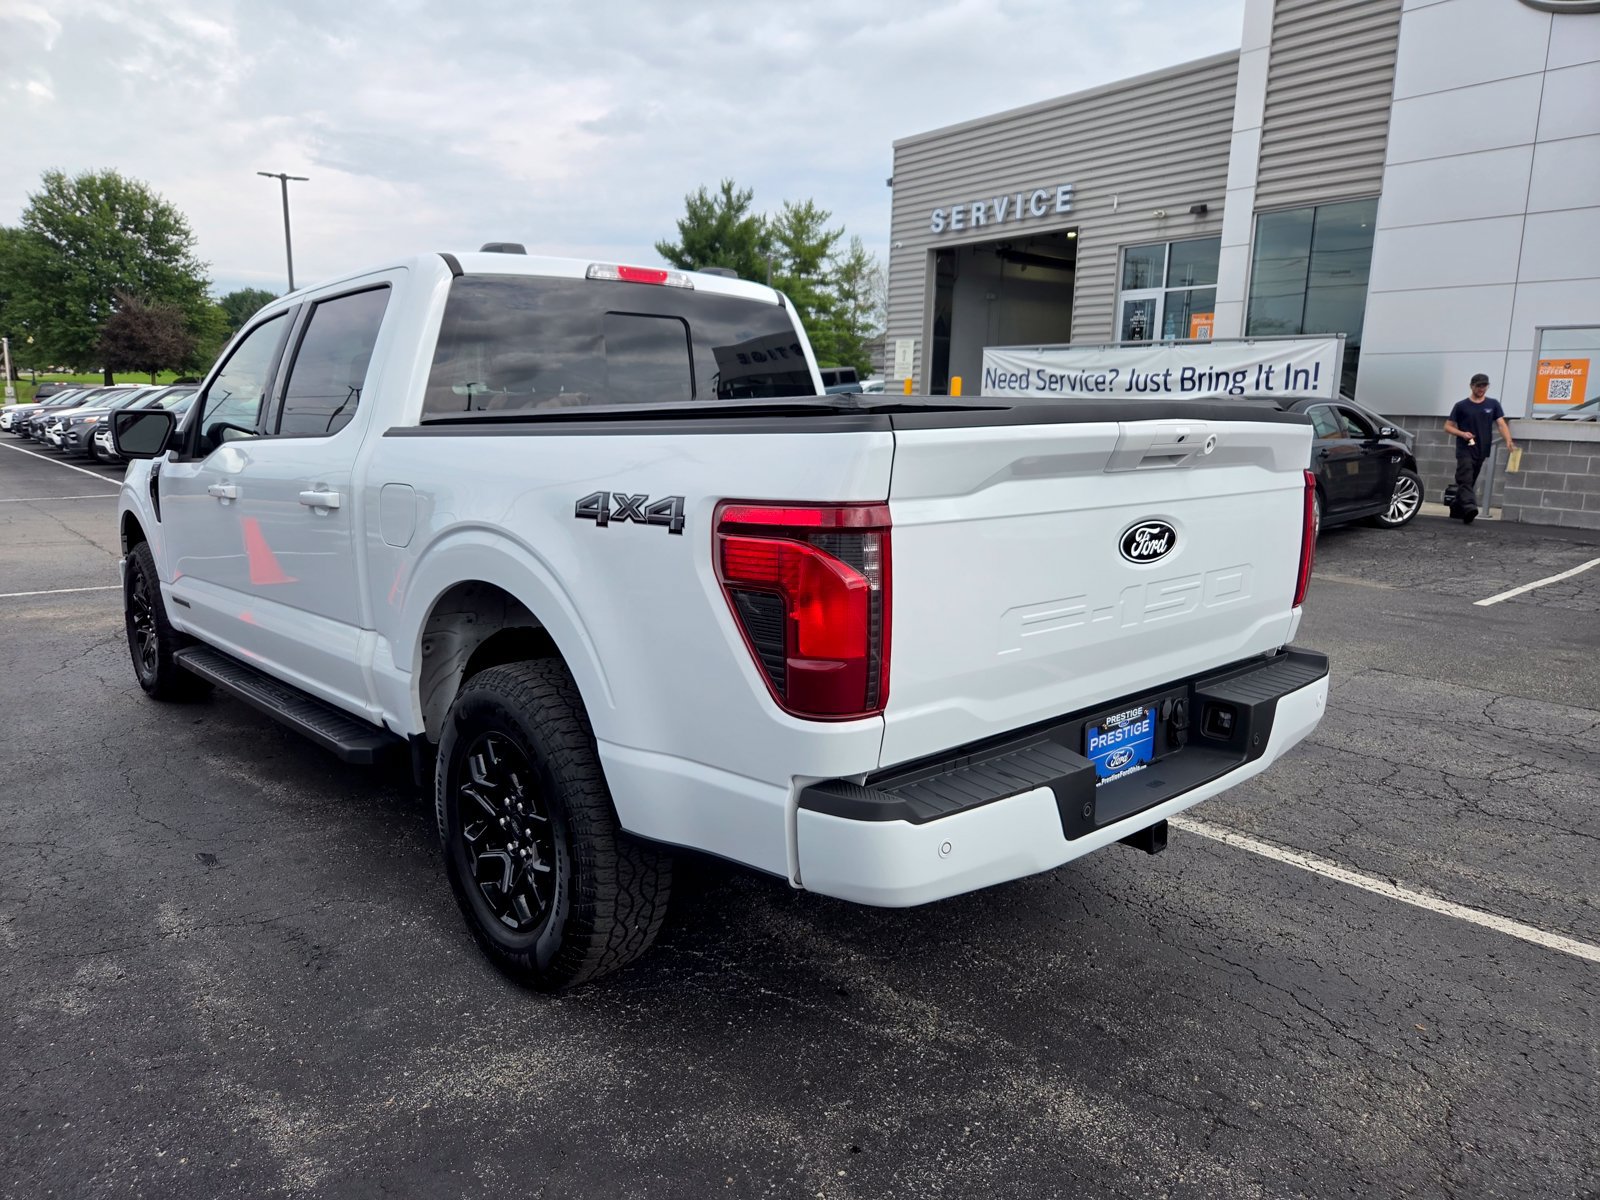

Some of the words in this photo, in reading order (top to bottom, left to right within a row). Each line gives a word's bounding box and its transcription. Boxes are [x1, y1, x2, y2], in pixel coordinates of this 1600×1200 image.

[930, 183, 1073, 234] SERVICE
[984, 367, 1030, 391] Need
[1035, 368, 1117, 392] Service?
[1125, 368, 1173, 393] Just
[1180, 366, 1248, 395] Bring
[1254, 364, 1275, 391] It
[1284, 361, 1320, 391] In!
[997, 563, 1254, 655] F-150
[1106, 706, 1143, 725] PRESTIGE
[1090, 719, 1149, 751] PRESTIGE
